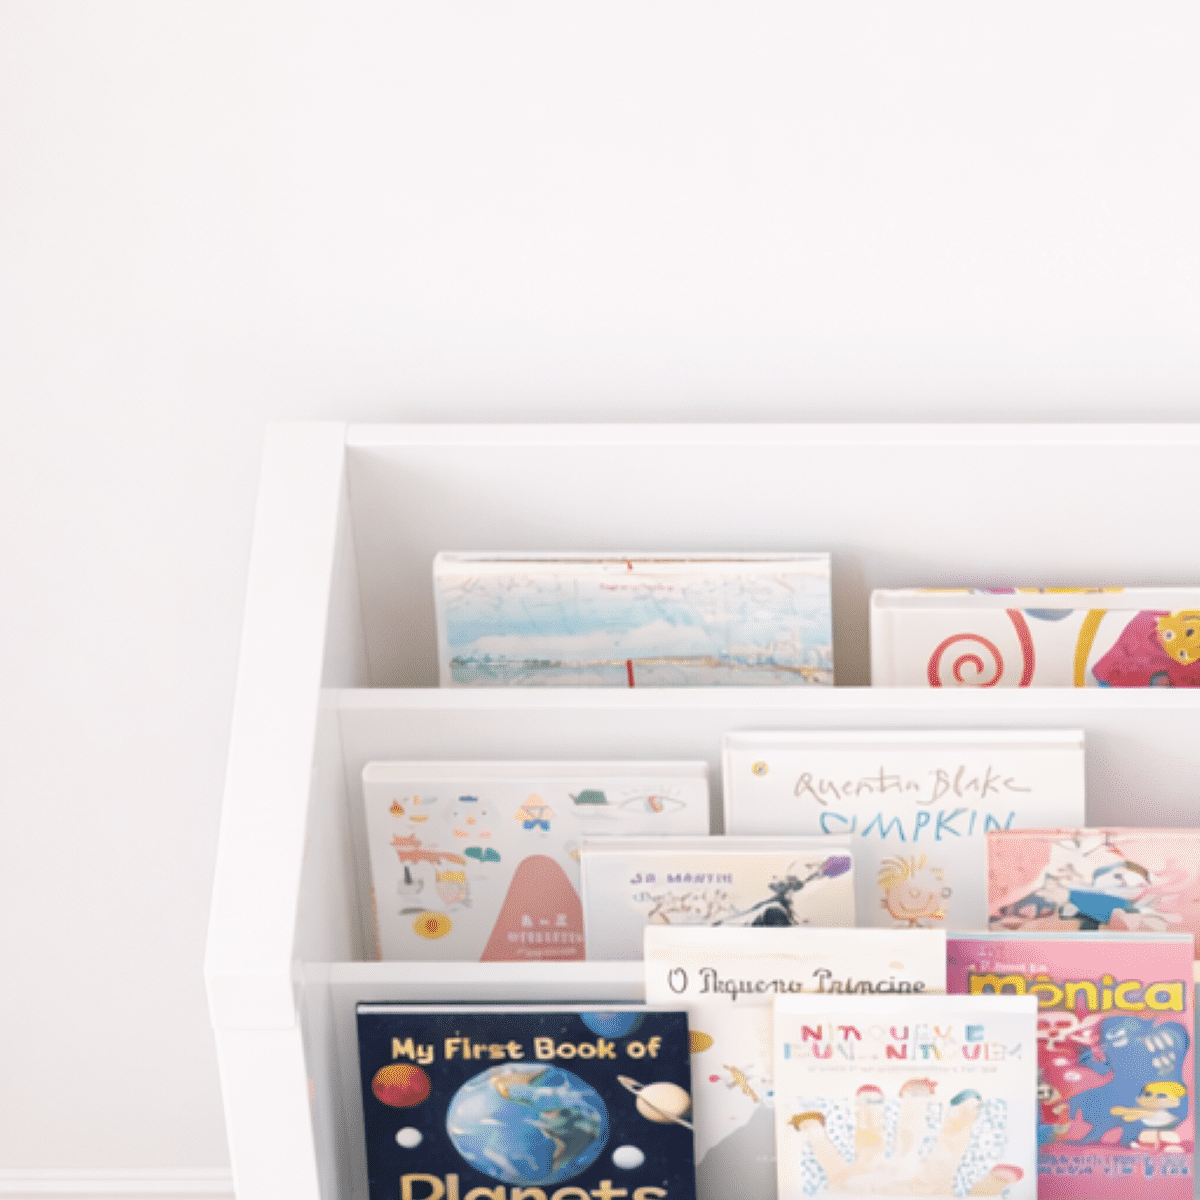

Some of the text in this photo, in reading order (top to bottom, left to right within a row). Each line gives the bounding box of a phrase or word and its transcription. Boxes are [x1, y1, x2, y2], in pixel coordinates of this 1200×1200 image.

[915, 765, 1032, 805] Blake
[391, 1036, 662, 1064] My First Book of
